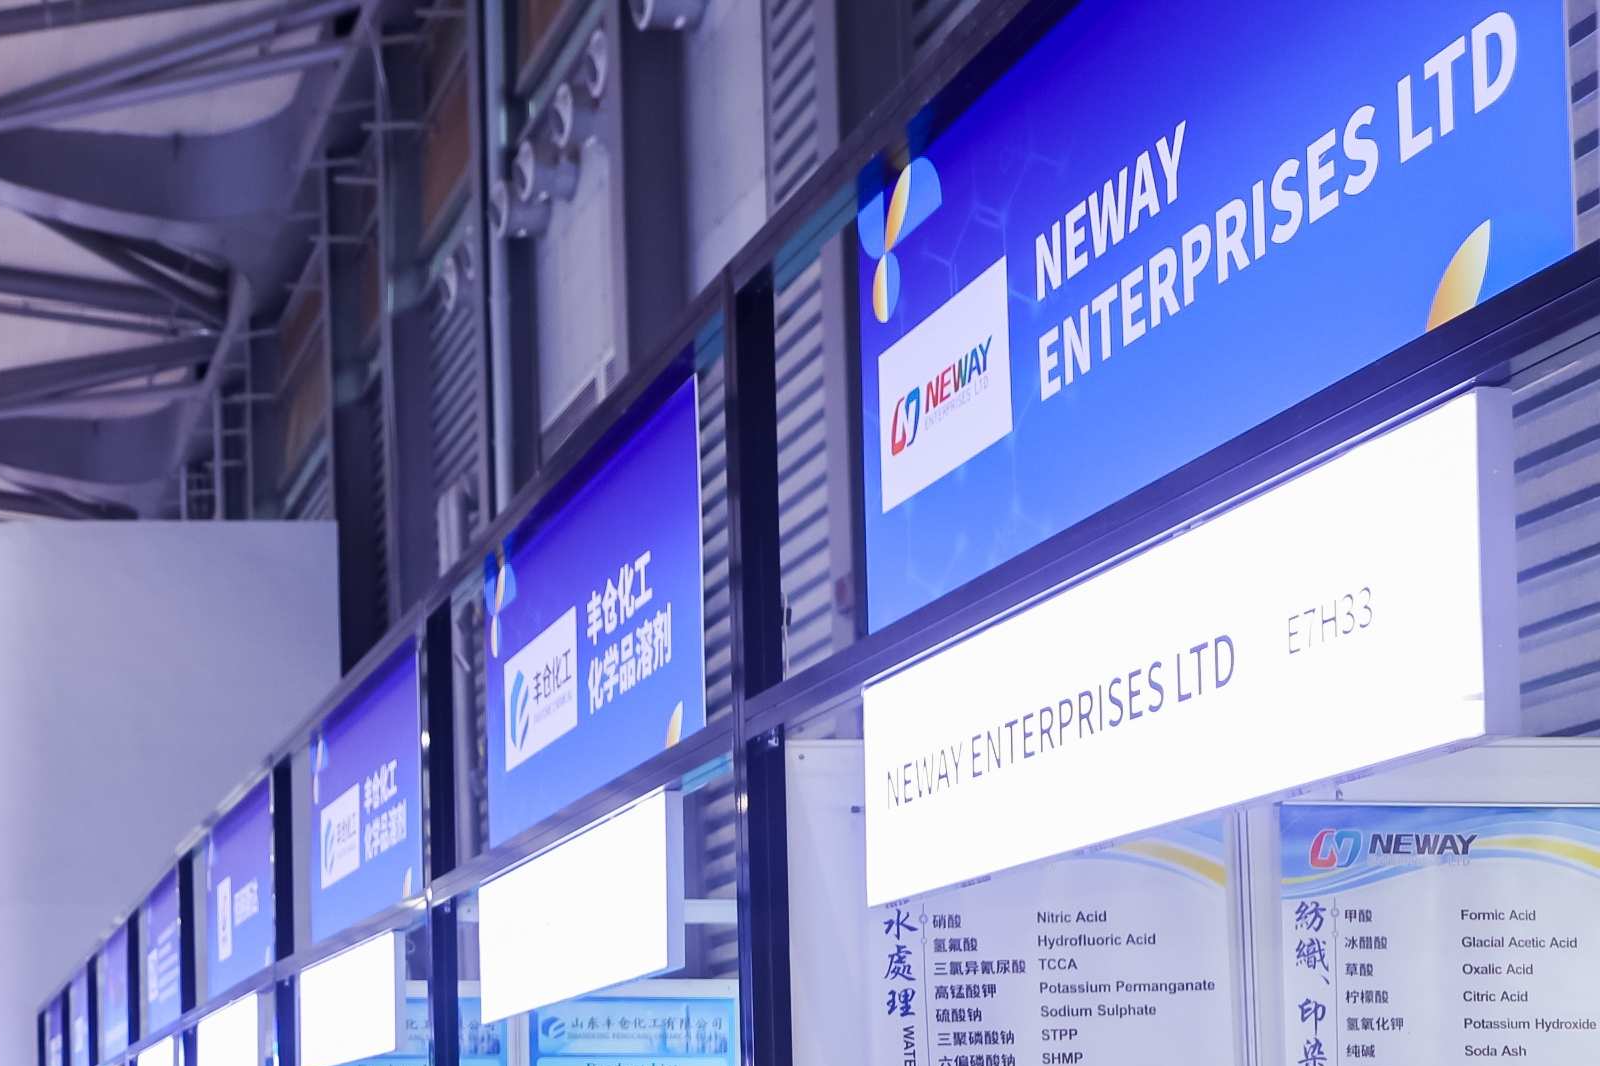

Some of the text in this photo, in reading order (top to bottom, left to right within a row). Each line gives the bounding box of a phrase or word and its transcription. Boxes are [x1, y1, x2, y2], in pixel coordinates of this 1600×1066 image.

[1036, 120, 1187, 301] NEWAY
[1039, 11, 1517, 402] ENTERPRISES LTD
[925, 334, 992, 415] NEWAY
[586, 550, 653, 646] 丰仓化工
[587, 601, 672, 716] 化学品溶剂
[533, 649, 571, 704] 丰仓化工
[886, 586, 1374, 810] NEWAY ENTERPRISES LTD E7H33
[1369, 834, 1478, 855] NEWAY
[932, 913, 962, 929] 硝酸
[1036, 910, 1107, 924] Nitric Acid
[1344, 908, 1373, 924] 甲酸
[1460, 908, 1536, 921] Formic Acid
[1037, 932, 1156, 950] Hydrofluoric Acid
[1344, 935, 1388, 950] 冰醋酸
[1461, 936, 1578, 949] Glacial Acetic Acid
[1037, 957, 1078, 971] TCCA
[1345, 962, 1374, 977] 草酸
[1462, 963, 1534, 976] Oxalic Acid
[1039, 979, 1215, 995] Potassium Permanganate
[1462, 990, 1529, 1003] Citric Acid
[935, 1007, 983, 1023] 硫酸钠
[1040, 1003, 1157, 1019] Sodium Sulphate
[1463, 1017, 1597, 1033] Potassium Hydroxide
[937, 1029, 1015, 1047] 三聚磷酸钠
[1041, 1028, 1078, 1041] STPP
[1042, 1051, 1084, 1065] SHMP
[1346, 1044, 1376, 1058] 纯碱
[1464, 1044, 1527, 1057] Soda Ash
